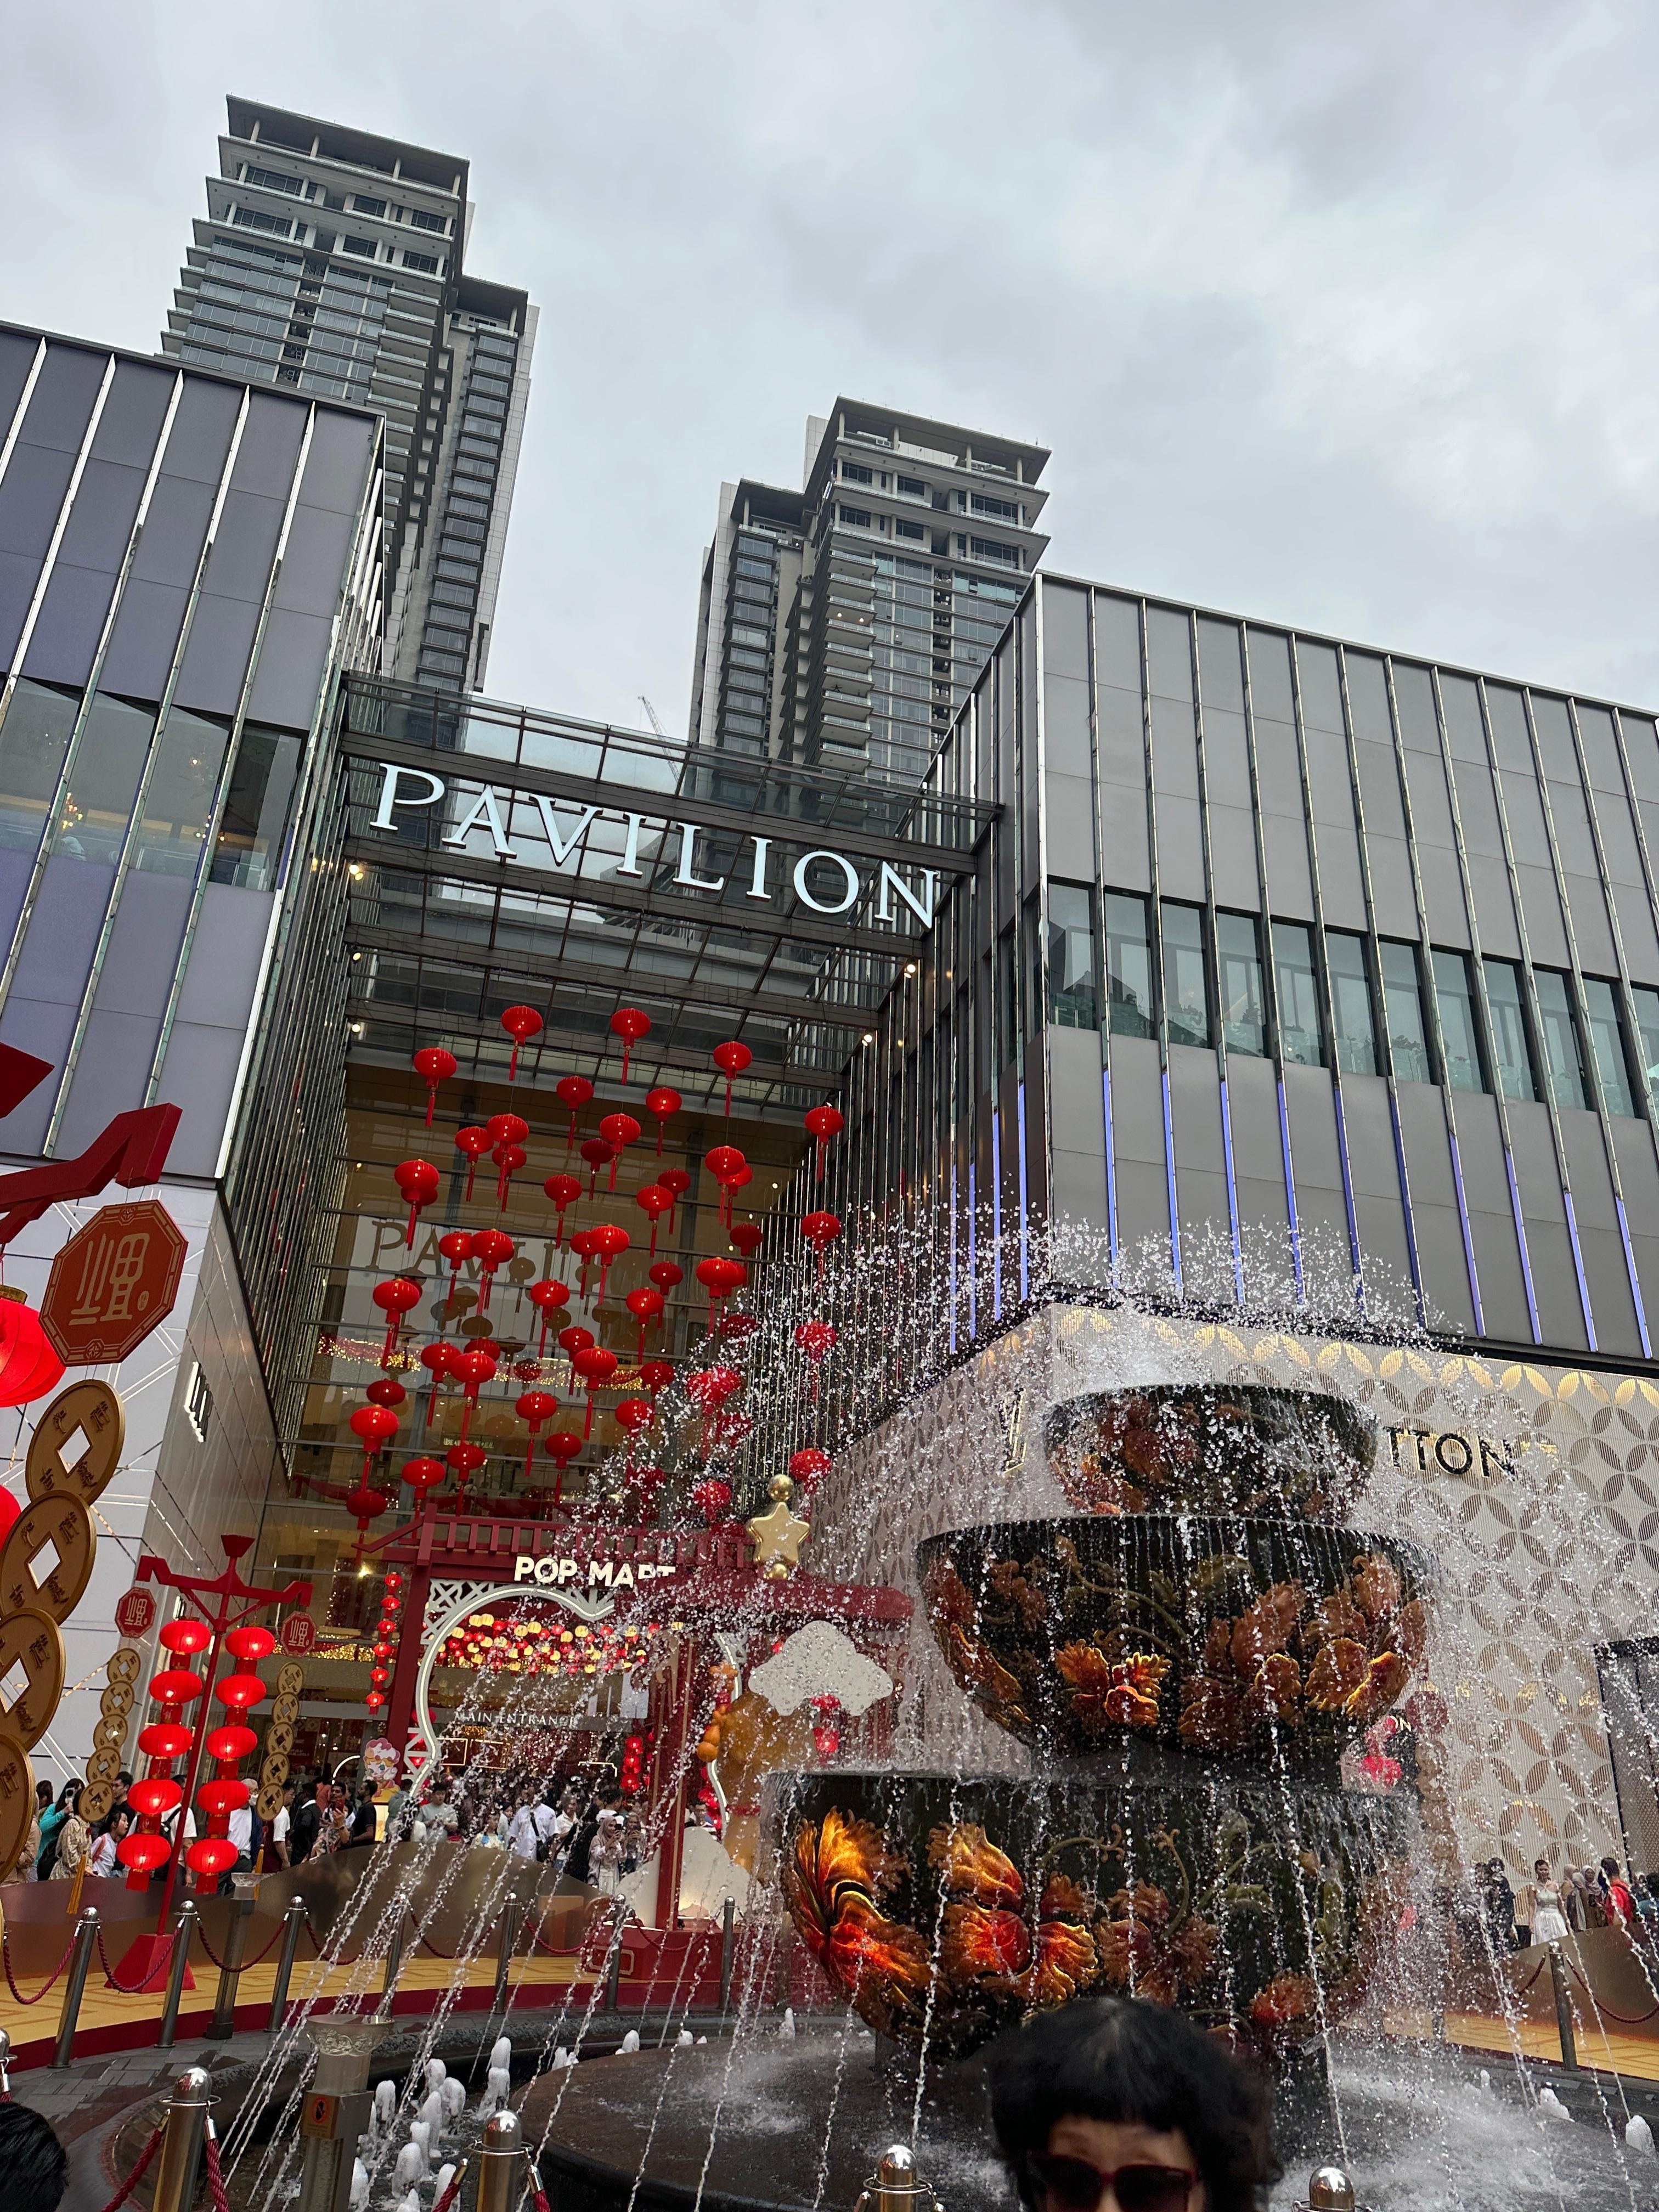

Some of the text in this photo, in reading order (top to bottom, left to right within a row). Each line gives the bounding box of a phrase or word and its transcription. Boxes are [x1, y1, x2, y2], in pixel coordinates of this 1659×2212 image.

[369, 763, 939, 930] PAVILION
[514, 1556, 578, 1584] POP
[454, 1711, 492, 1723] MAIN
